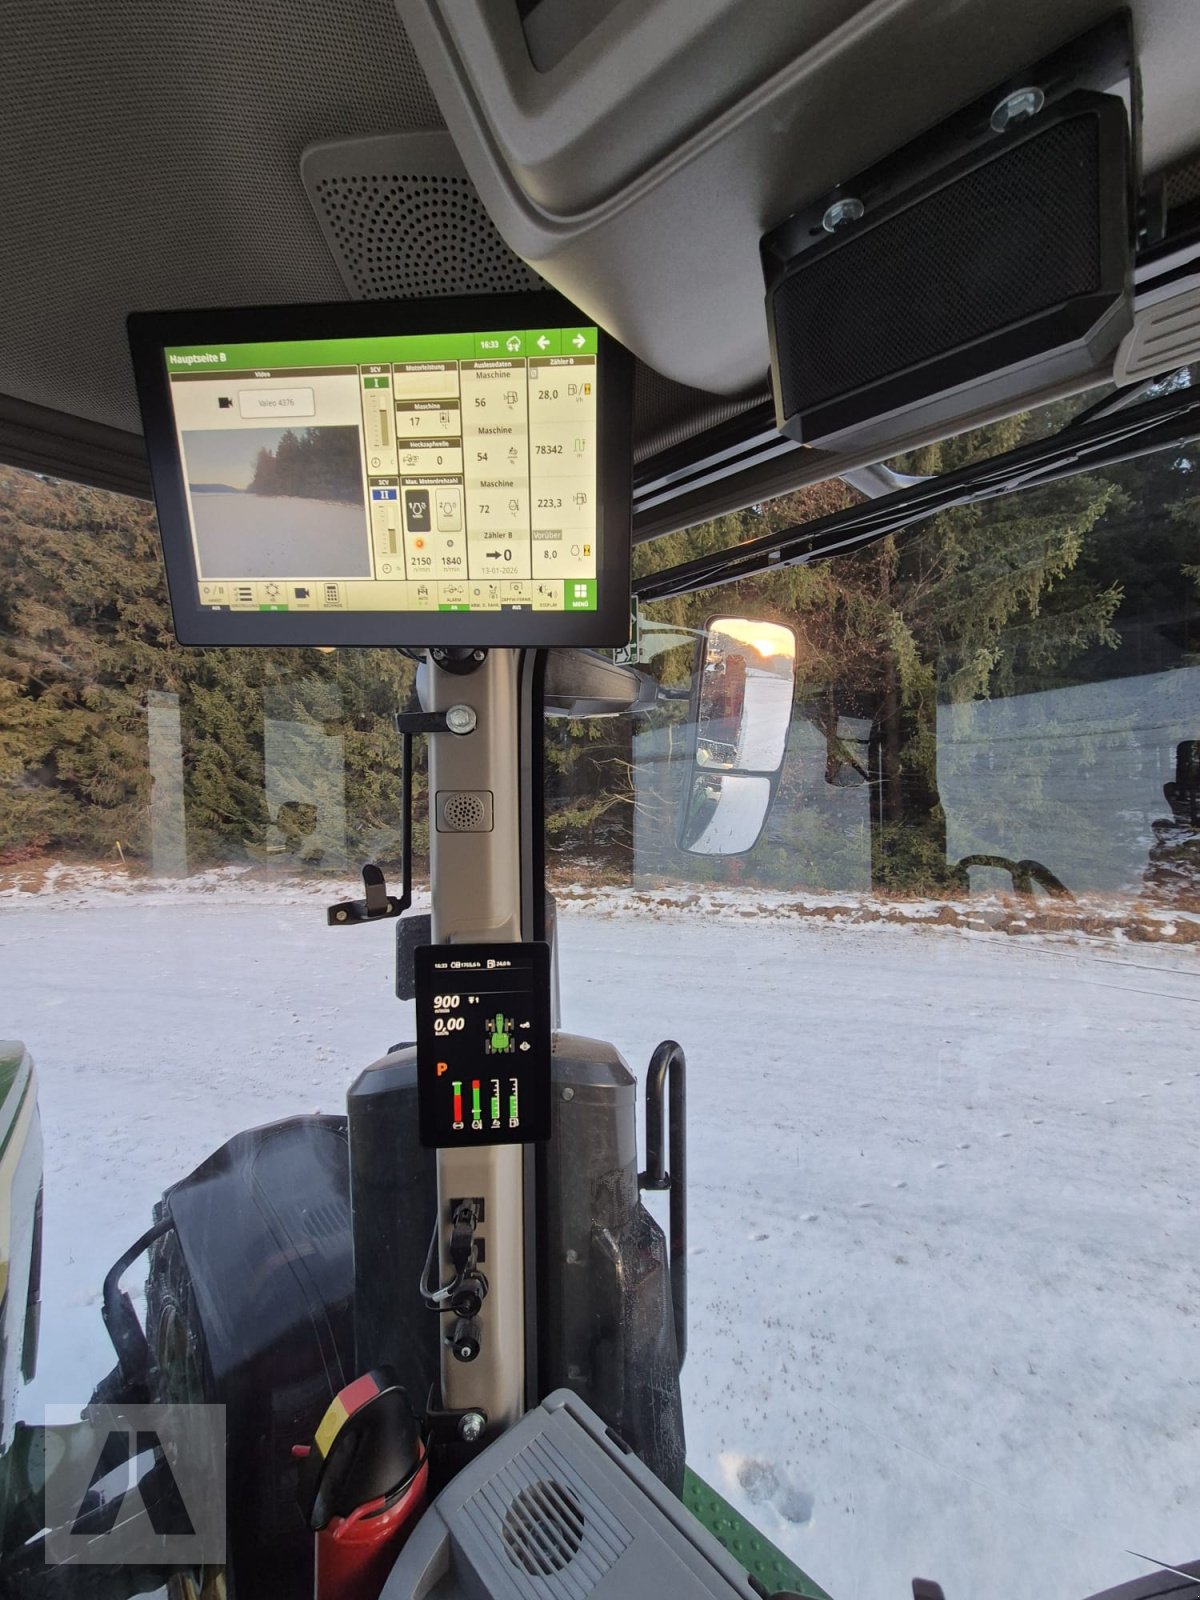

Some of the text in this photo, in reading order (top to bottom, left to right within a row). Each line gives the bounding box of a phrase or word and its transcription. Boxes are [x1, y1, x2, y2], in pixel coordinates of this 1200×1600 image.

[169, 352, 227, 366] Hauptseite B
[476, 371, 511, 379] Maschine
[538, 390, 558, 400] 28,0
[475, 398, 486, 407] 56
[410, 417, 420, 426] 17
[536, 445, 563, 455] 78342
[437, 456, 443, 465] 0
[477, 452, 488, 461] 54
[480, 480, 514, 488] Maschine
[538, 499, 562, 509] 223,3
[479, 505, 490, 514] 72
[544, 550, 557, 560] 8,0
[412, 557, 431, 565] 2150
[442, 557, 461, 565] 1840
[434, 995, 460, 1009] 900
[434, 1017, 465, 1031] 0,00
[437, 1063, 448, 1076] P
